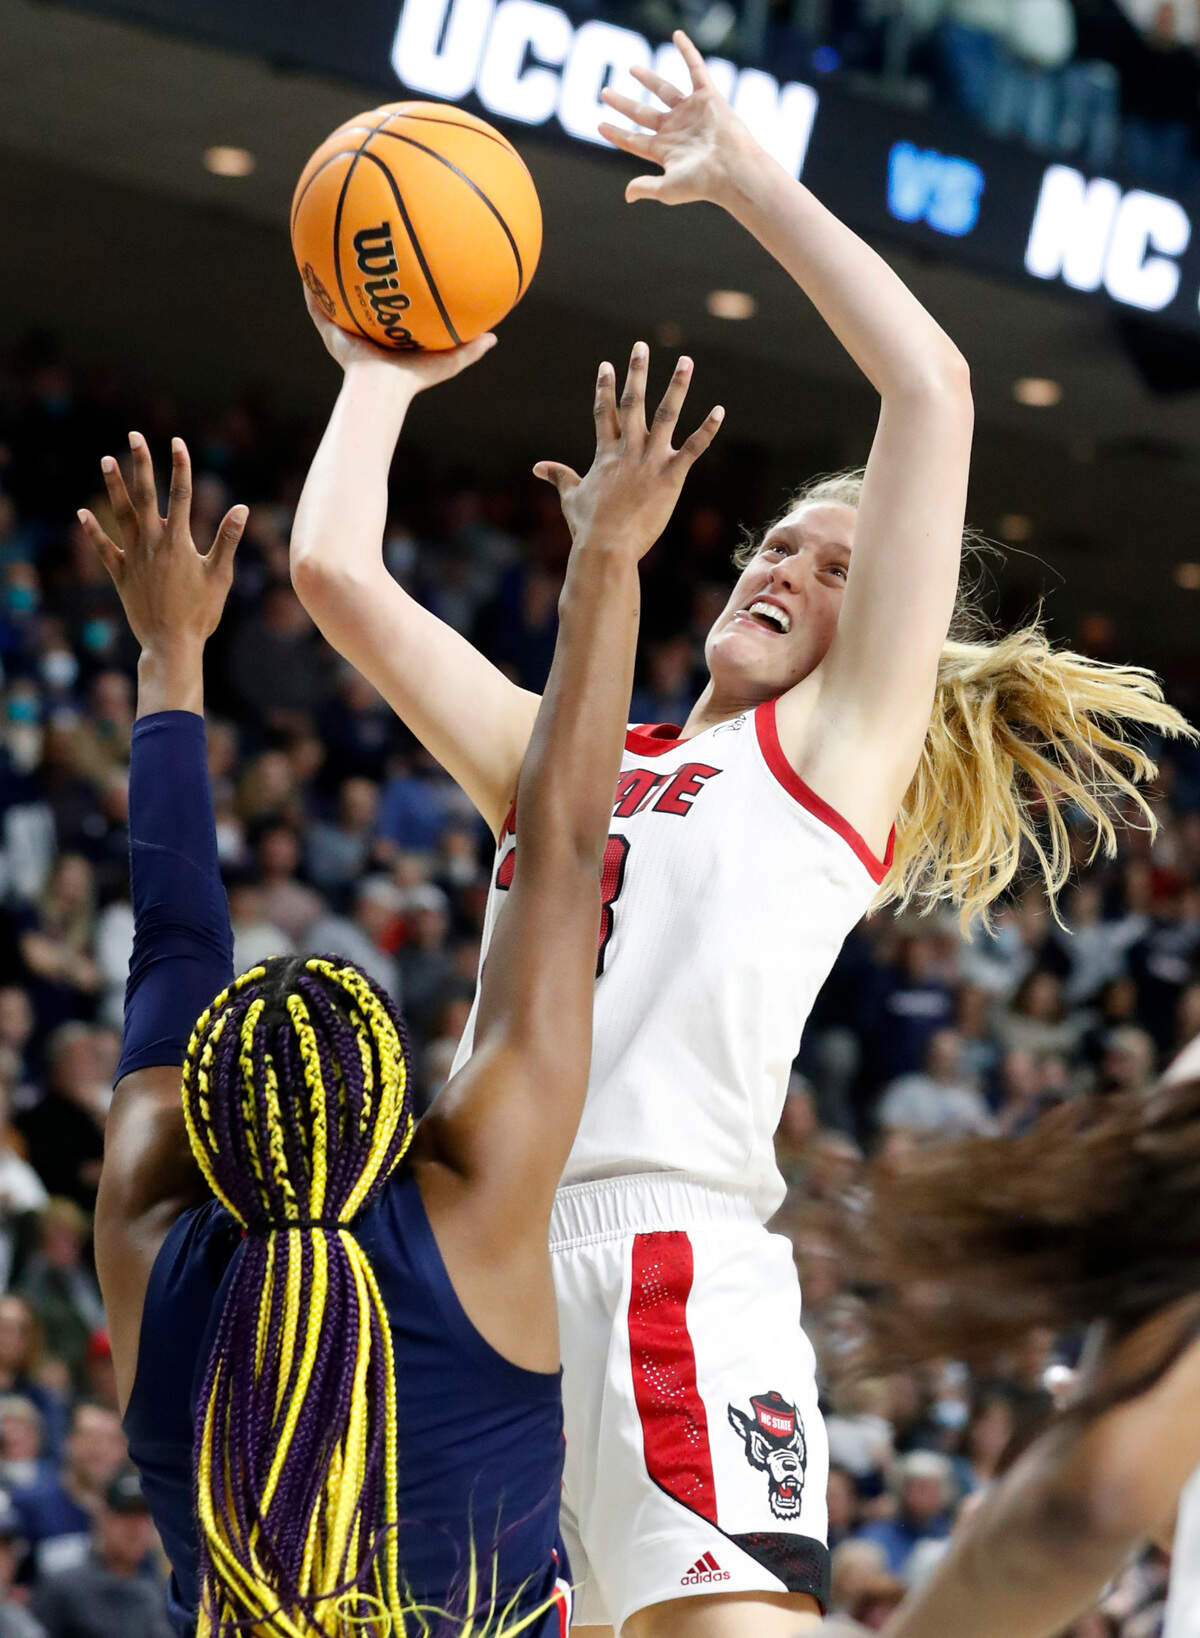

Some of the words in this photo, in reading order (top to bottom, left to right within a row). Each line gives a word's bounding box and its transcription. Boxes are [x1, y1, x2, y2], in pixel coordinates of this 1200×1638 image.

[887, 140, 984, 236] VS
[1024, 163, 1192, 312] NC
[760, 1411, 771, 1426] NC
[772, 1416, 792, 1431] STATE
[680, 1570, 731, 1585] adidas
